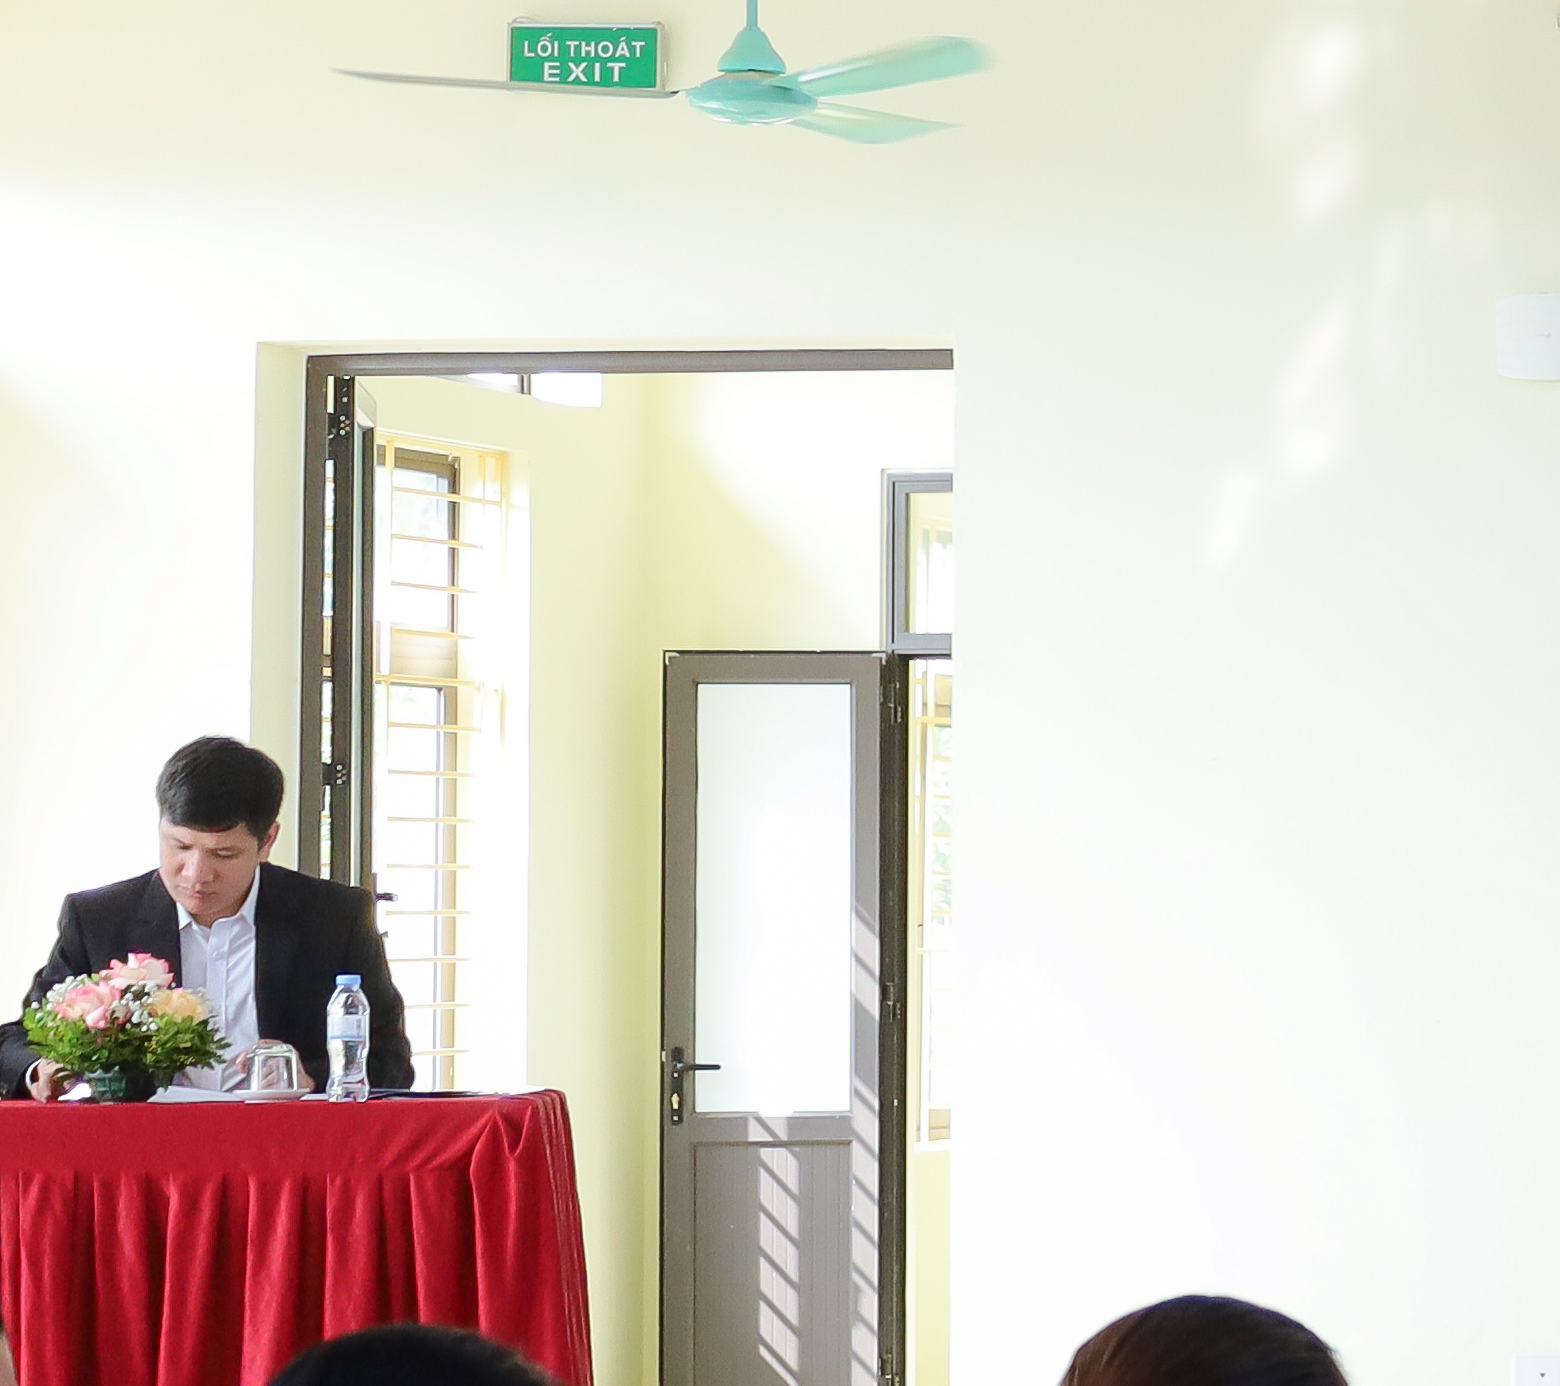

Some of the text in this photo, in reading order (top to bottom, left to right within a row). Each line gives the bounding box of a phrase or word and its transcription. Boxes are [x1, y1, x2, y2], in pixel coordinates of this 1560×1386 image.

[523, 33, 646, 58] LỐI THOÁT
[543, 62, 626, 83] EXIT
